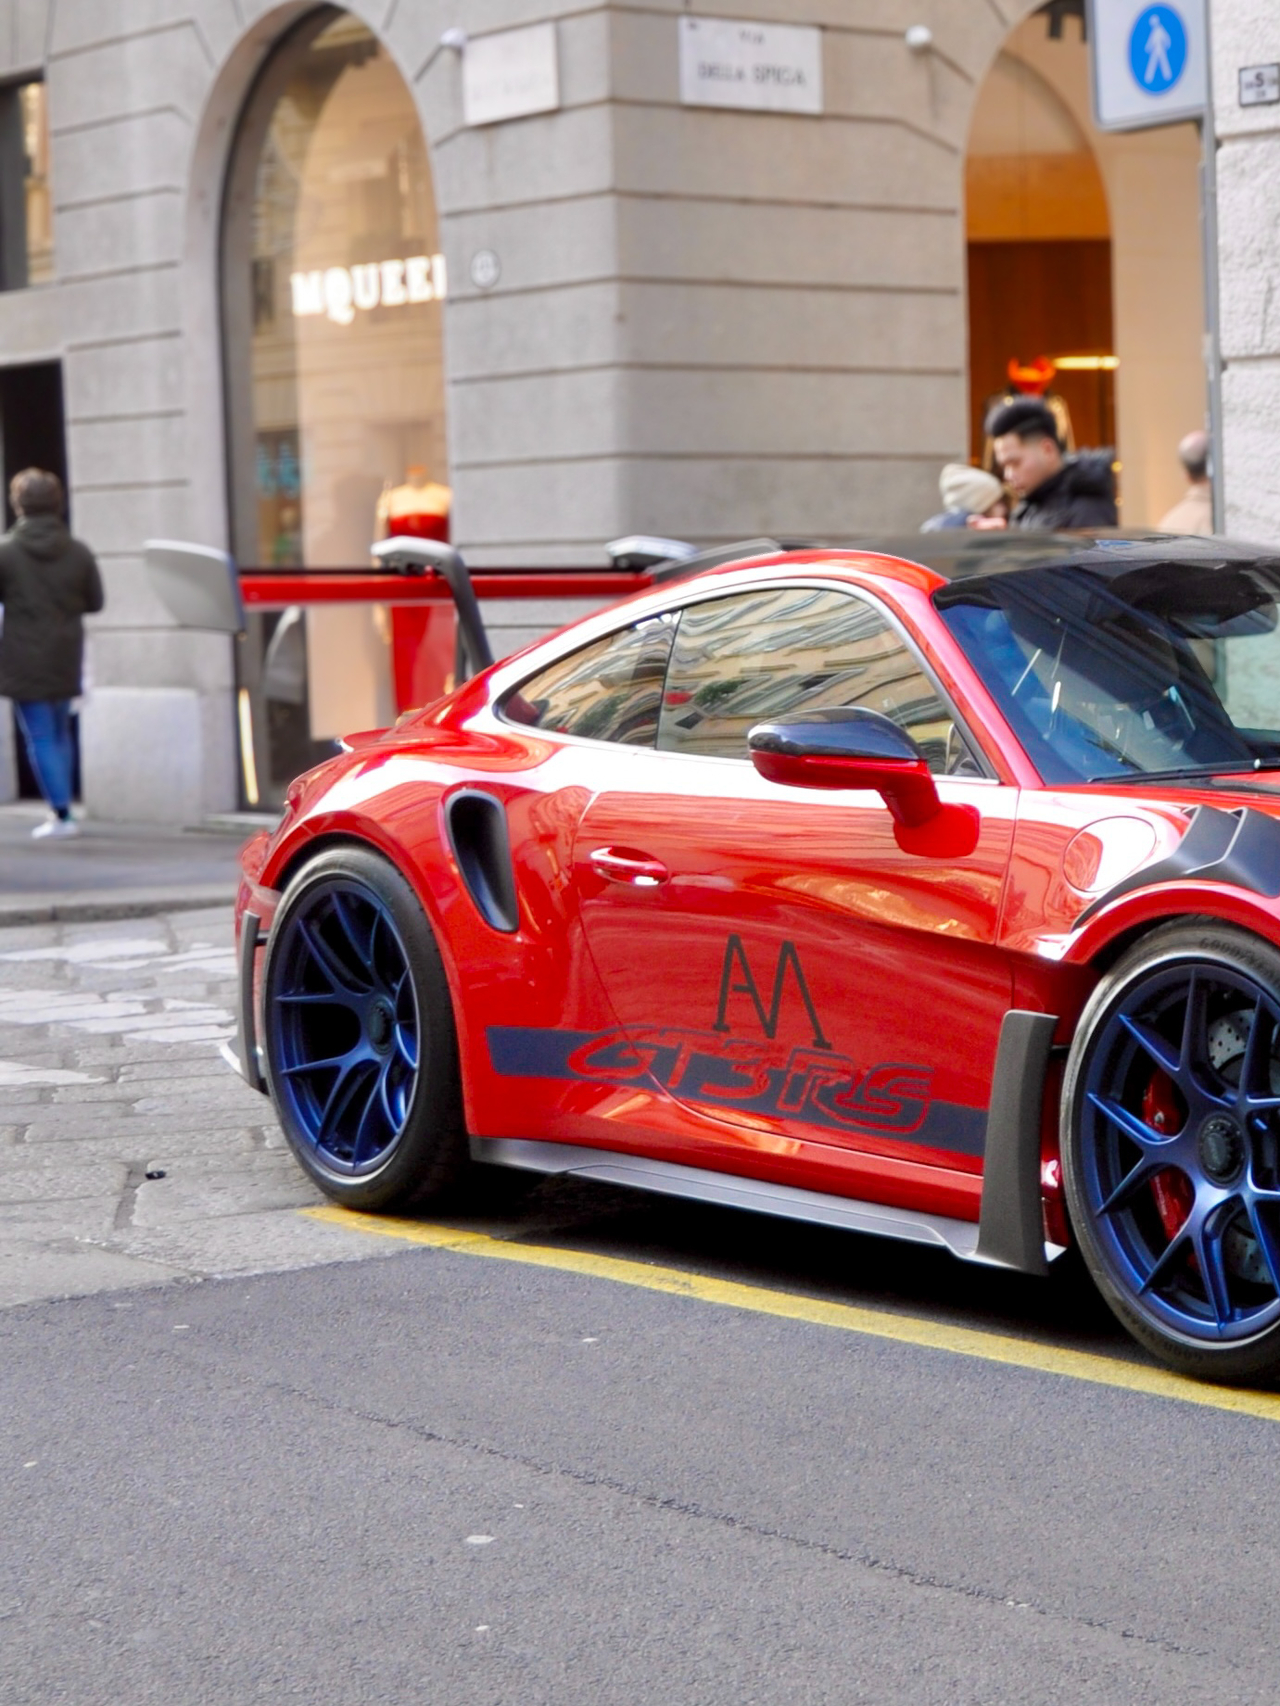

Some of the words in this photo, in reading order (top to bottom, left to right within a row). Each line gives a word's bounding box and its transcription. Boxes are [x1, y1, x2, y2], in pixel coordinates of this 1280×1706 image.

[697, 61, 746, 82] DELLA
[752, 63, 807, 88] SPIGA
[1254, 72, 1265, 88] S
